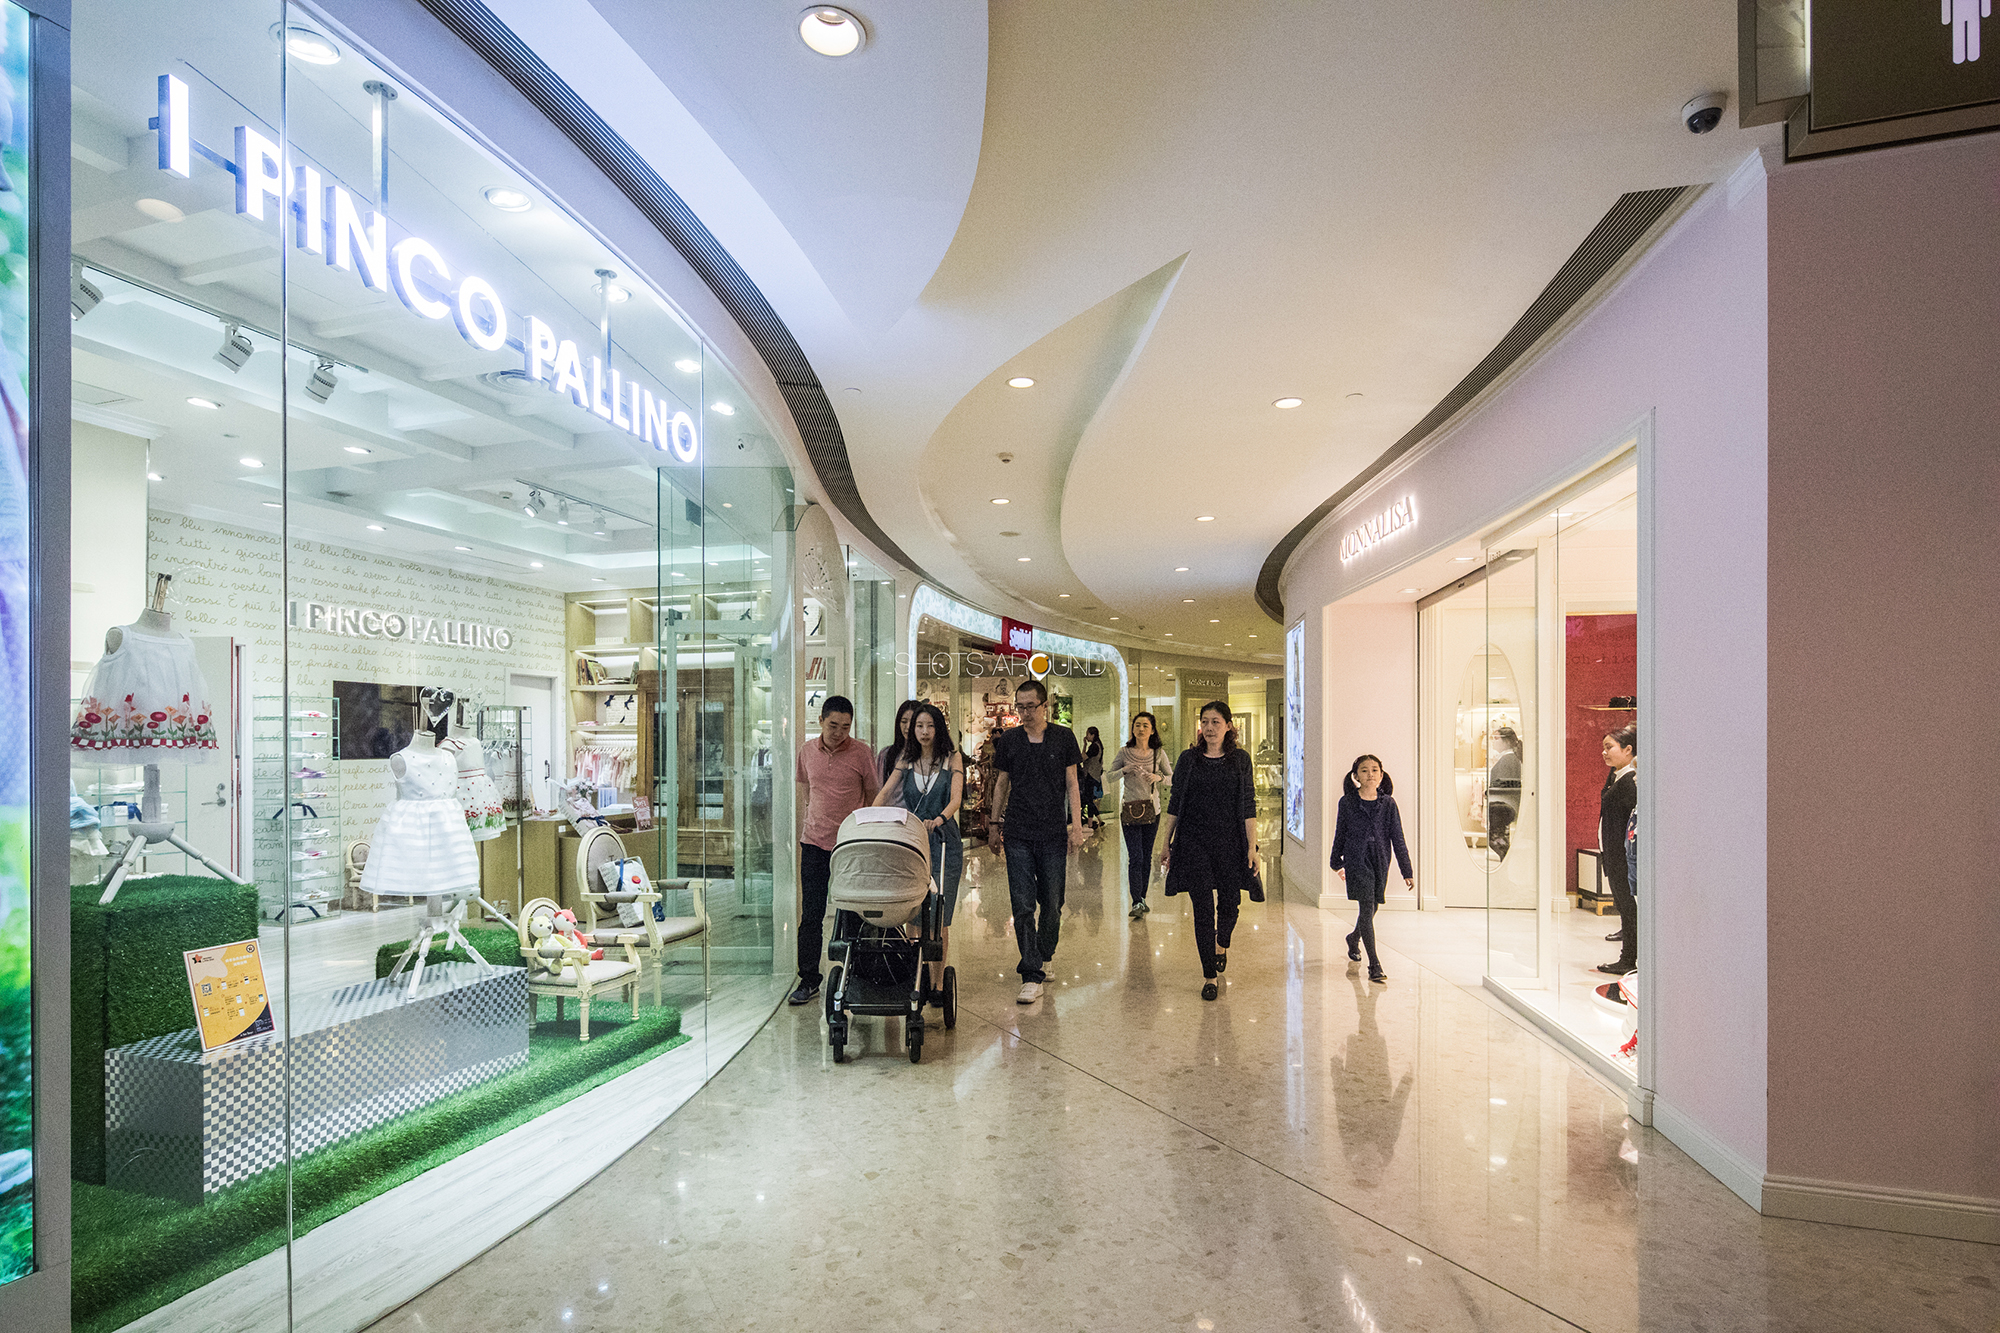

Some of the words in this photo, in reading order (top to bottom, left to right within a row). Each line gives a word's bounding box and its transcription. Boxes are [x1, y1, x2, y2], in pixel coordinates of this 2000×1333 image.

[158, 74, 190, 179] I
[235, 126, 507, 351] PINCO
[524, 315, 698, 463] PALLINO
[180, 516, 205, 532] blu
[212, 525, 283, 546] innamorat
[293, 540, 313, 553] del
[319, 543, 340, 557] blu
[1340, 495, 1417, 562] MONNALISA
[176, 536, 212, 551] tutti
[303, 557, 325, 571] blu
[184, 574, 214, 588] utti
[257, 563, 306, 584] bamino
[311, 577, 339, 589] rosso
[184, 609, 219, 625] bello
[308, 602, 406, 638] PINCO
[410, 616, 514, 651] PALLINO
